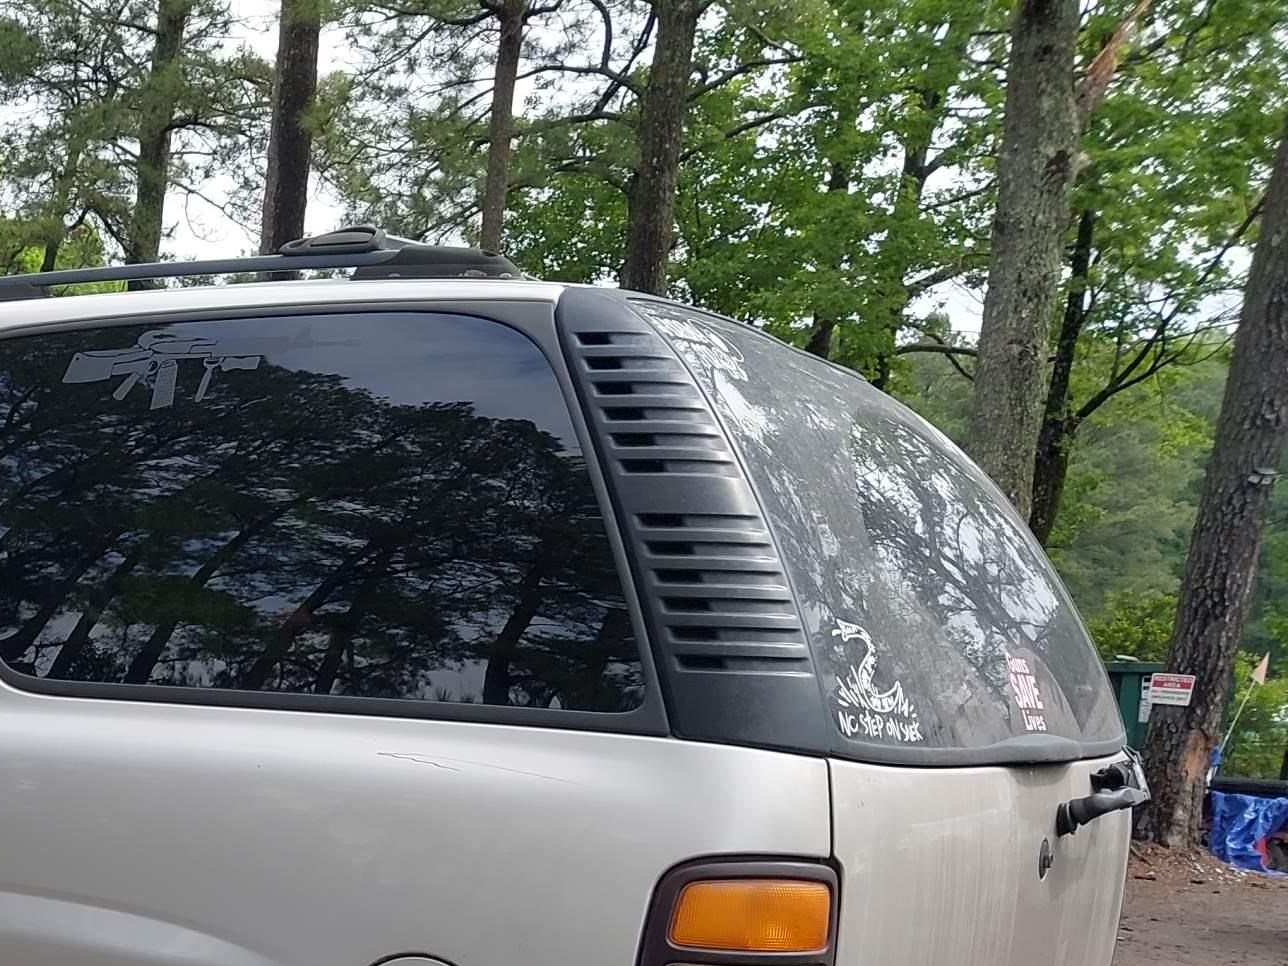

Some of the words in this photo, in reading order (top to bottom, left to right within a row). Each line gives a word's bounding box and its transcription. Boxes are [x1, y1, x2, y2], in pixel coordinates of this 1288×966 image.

[1009, 672, 1044, 710] SAVE
[885, 716, 902, 741] ON
[1021, 709, 1047, 731] Lives
